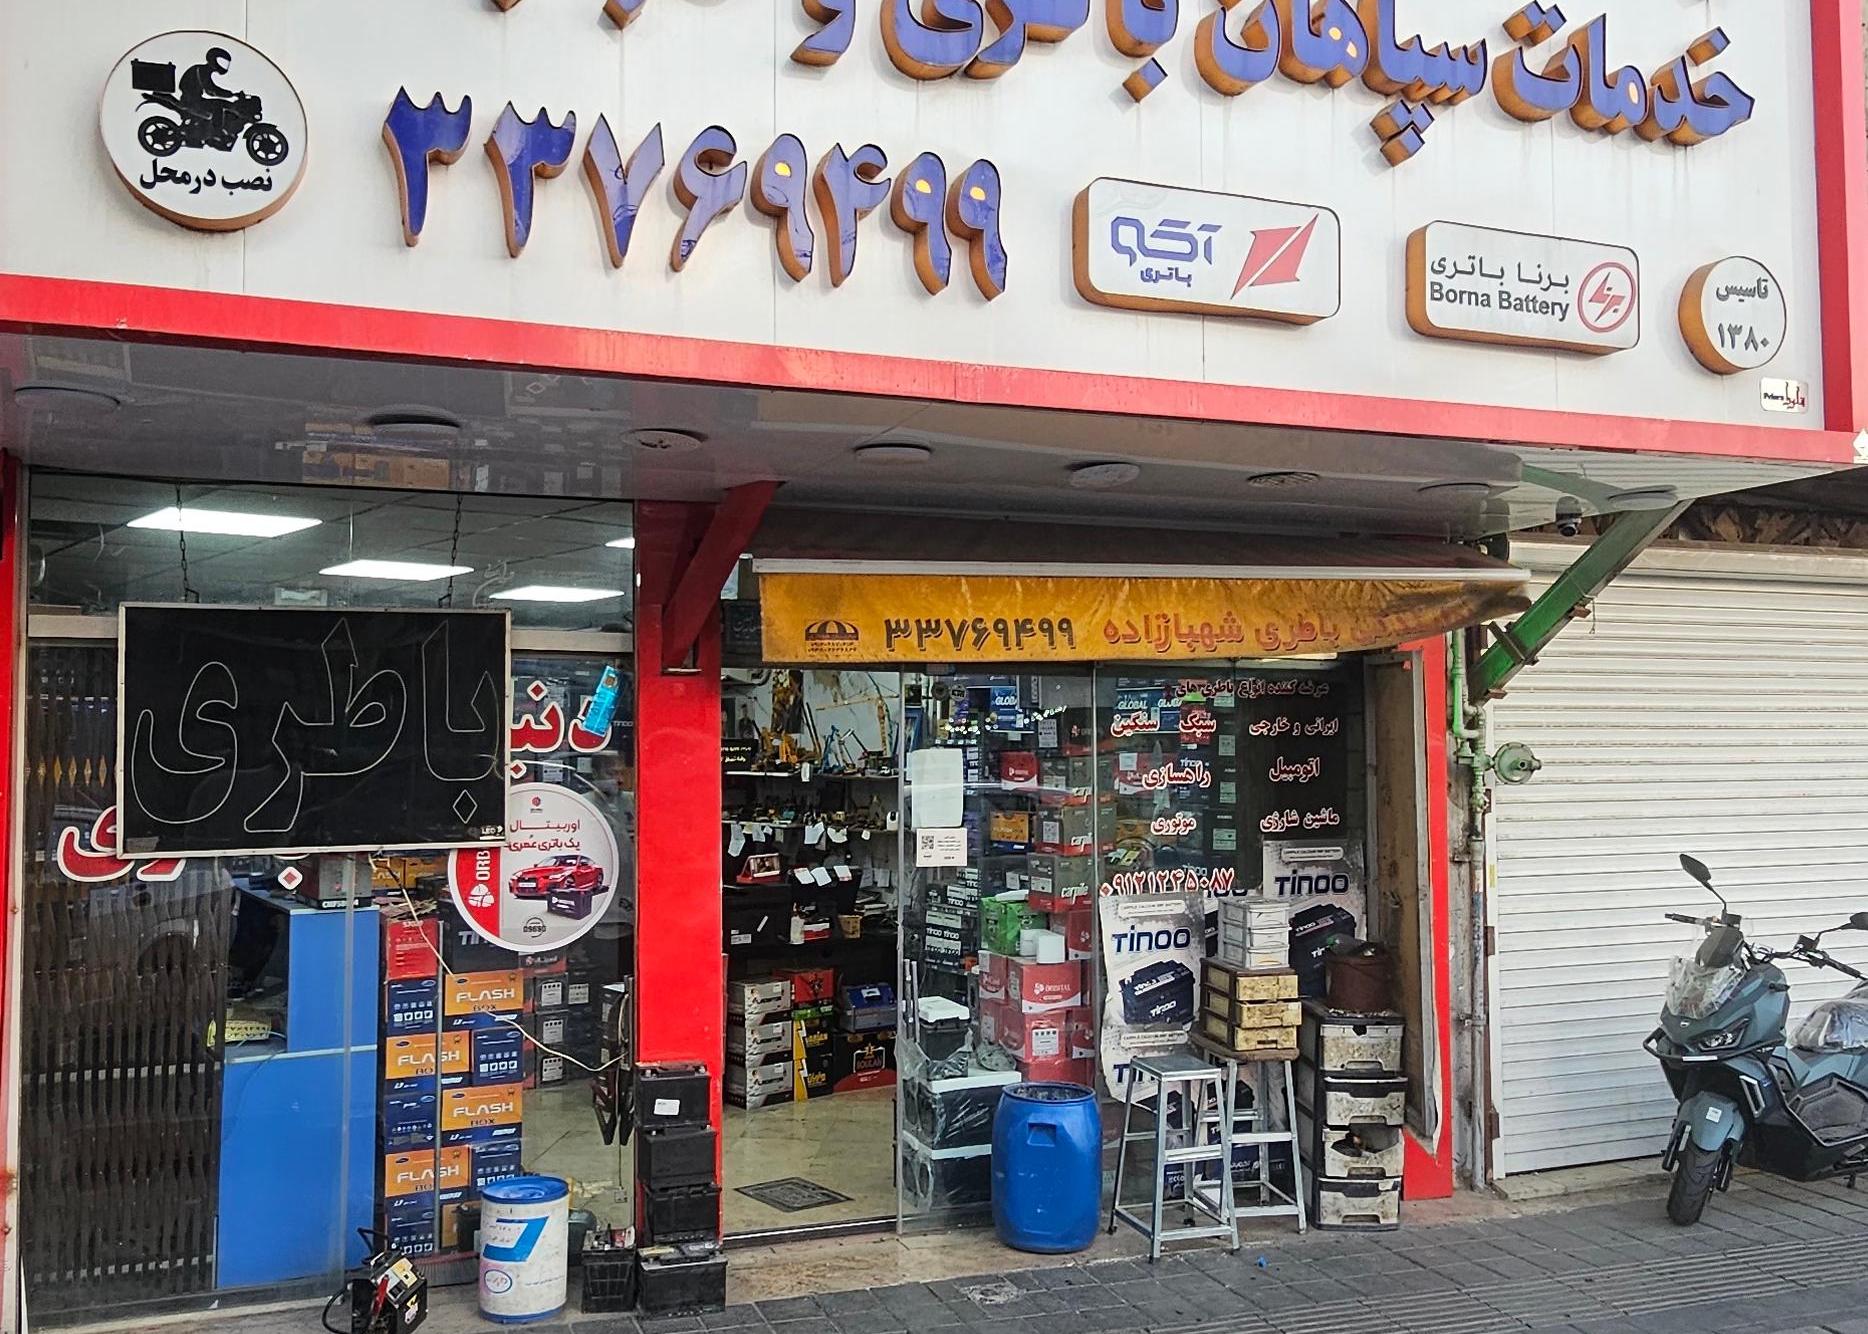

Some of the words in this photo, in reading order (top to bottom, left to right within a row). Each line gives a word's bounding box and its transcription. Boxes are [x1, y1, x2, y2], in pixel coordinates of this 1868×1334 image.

[1491, 0, 1756, 147] خدمات
[221, 167, 273, 196] نصب
[381, 85, 1008, 303] ۳۳۷۶۹۴۹۹
[1139, 266, 1193, 288] باتری
[1429, 253, 1506, 285] باتری
[1516, 262, 1570, 294] برنا
[1429, 281, 1492, 308] Borna
[1498, 290, 1570, 323] Battery
[1715, 276, 1770, 303] تاسیس
[1716, 321, 1771, 353] ۱۳۸۰
[883, 617, 1077, 653] ۳۳۷۶۹۴۹۹
[1254, 611, 1341, 651] باطری
[1175, 679, 1199, 699] های
[1200, 678, 1234, 699] باطری
[1237, 677, 1266, 700] انواع
[131, 616, 500, 833] باطری
[1110, 710, 1160, 738] سنگین
[1178, 712, 1217, 738] سبک
[1248, 716, 1291, 737] خارجی
[1292, 722, 1302, 736] و
[1304, 716, 1340, 736] ایرانی
[1268, 755, 1321, 783] اتومبیل
[509, 819, 580, 834] اوربیتال
[1150, 812, 1197, 836] موتوری
[1259, 808, 1300, 833] شارژی
[1302, 807, 1341, 830] ماشین
[538, 837, 563, 852] باتری
[564, 837, 581, 852] یک
[1099, 867, 1235, 898] ۰۹۱۲۱۲۴۵۰۸۷
[455, 987, 516, 1004] FLASH
[453, 1101, 514, 1118] FLASH
